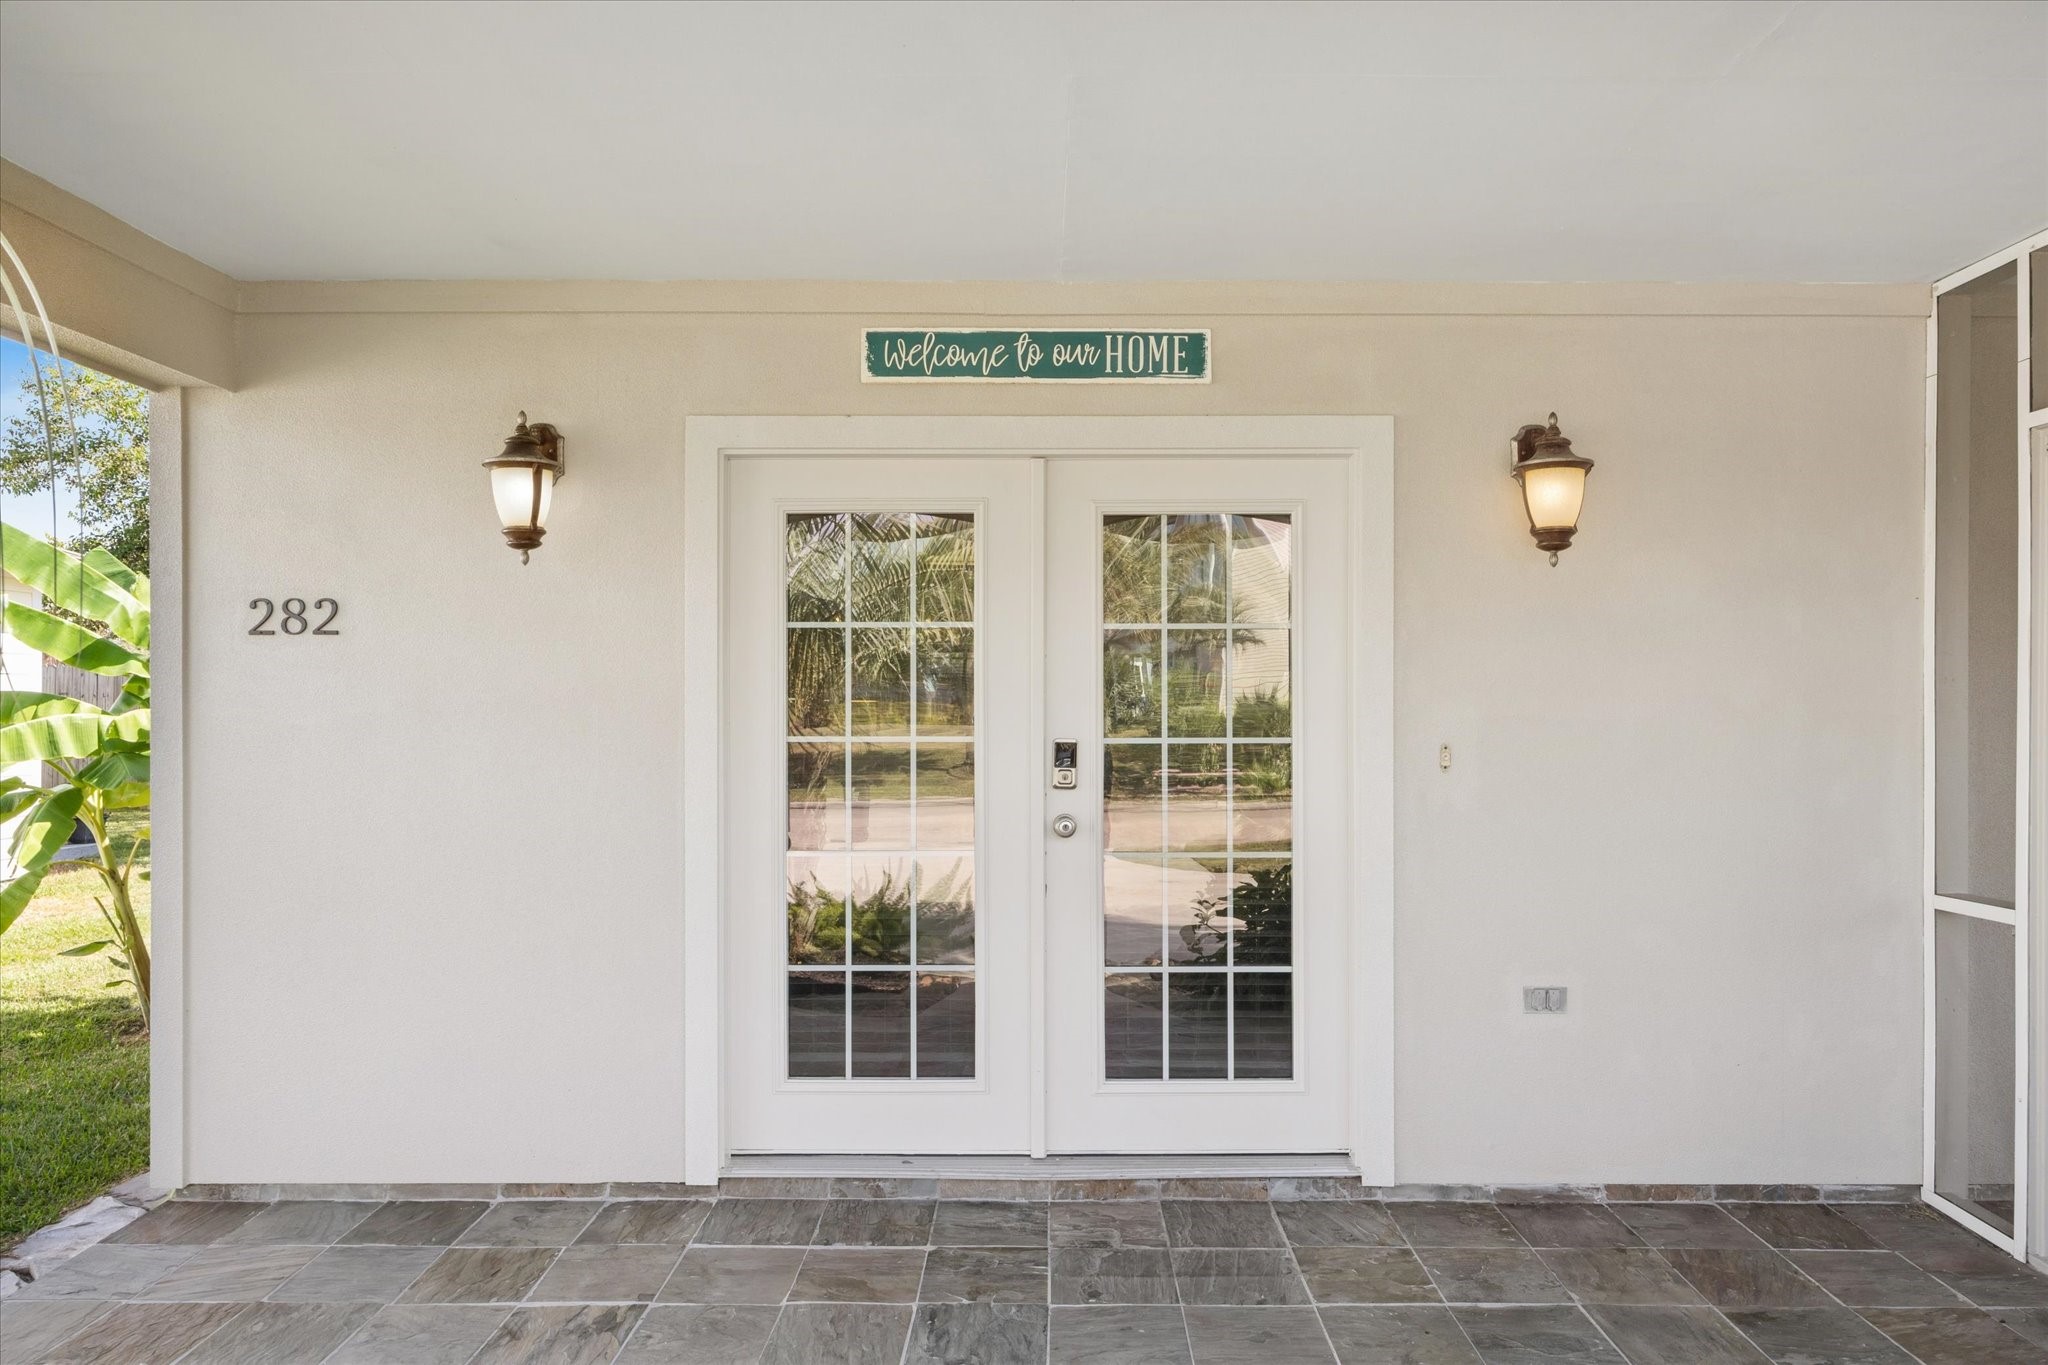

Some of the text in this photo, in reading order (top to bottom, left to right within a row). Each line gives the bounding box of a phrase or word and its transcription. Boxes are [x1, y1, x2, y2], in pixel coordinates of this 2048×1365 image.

[1013, 332, 1043, 372] to
[1052, 339, 1101, 367] our
[1104, 335, 1189, 374] HOME
[248, 597, 340, 635] 282
